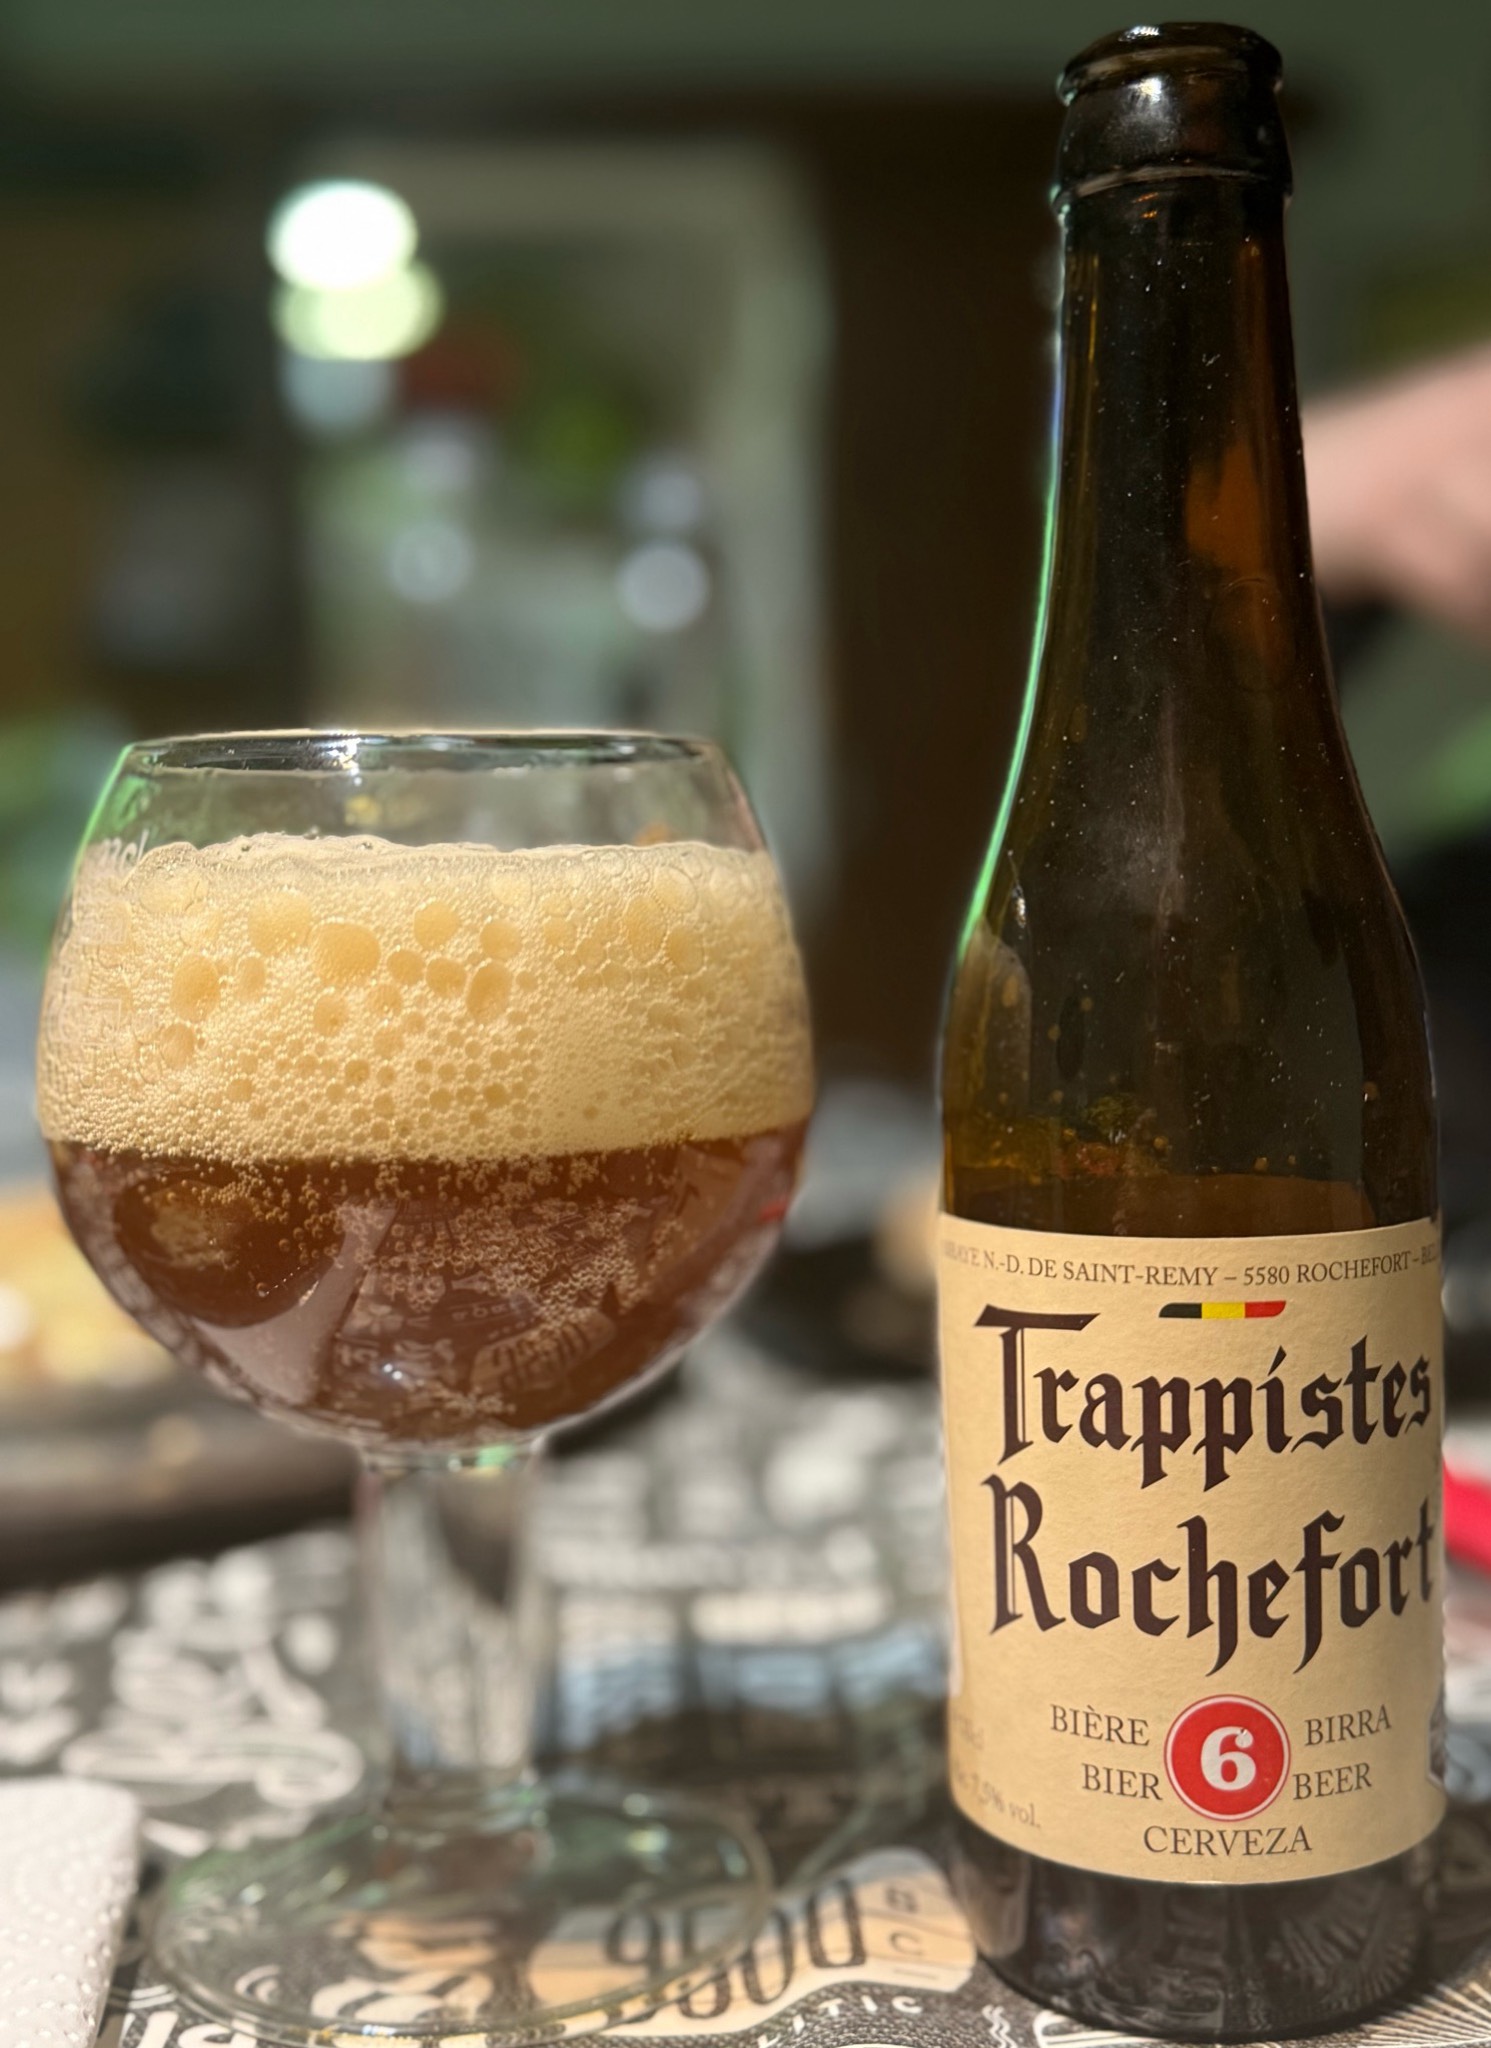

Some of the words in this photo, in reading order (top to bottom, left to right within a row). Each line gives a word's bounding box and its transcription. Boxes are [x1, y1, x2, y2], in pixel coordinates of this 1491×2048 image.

[1028, 1257, 1057, 1278] DE
[1063, 1261, 1218, 1286] SAINT-REMY
[1243, 1266, 1290, 1286] 5580
[1296, 1250, 1411, 1283] ROCHEFORT
[974, 1304, 1430, 1493] Trappistes
[981, 1473, 1436, 1678] Rochefort
[1050, 1703, 1150, 1748] BIÈRE
[1305, 1704, 1391, 1747] BIRRA
[1200, 1725, 1256, 1792] 6
[1081, 1762, 1162, 1801] BIER
[1293, 1762, 1372, 1801] BEER
[1143, 1825, 1313, 1857] CERVEZA
